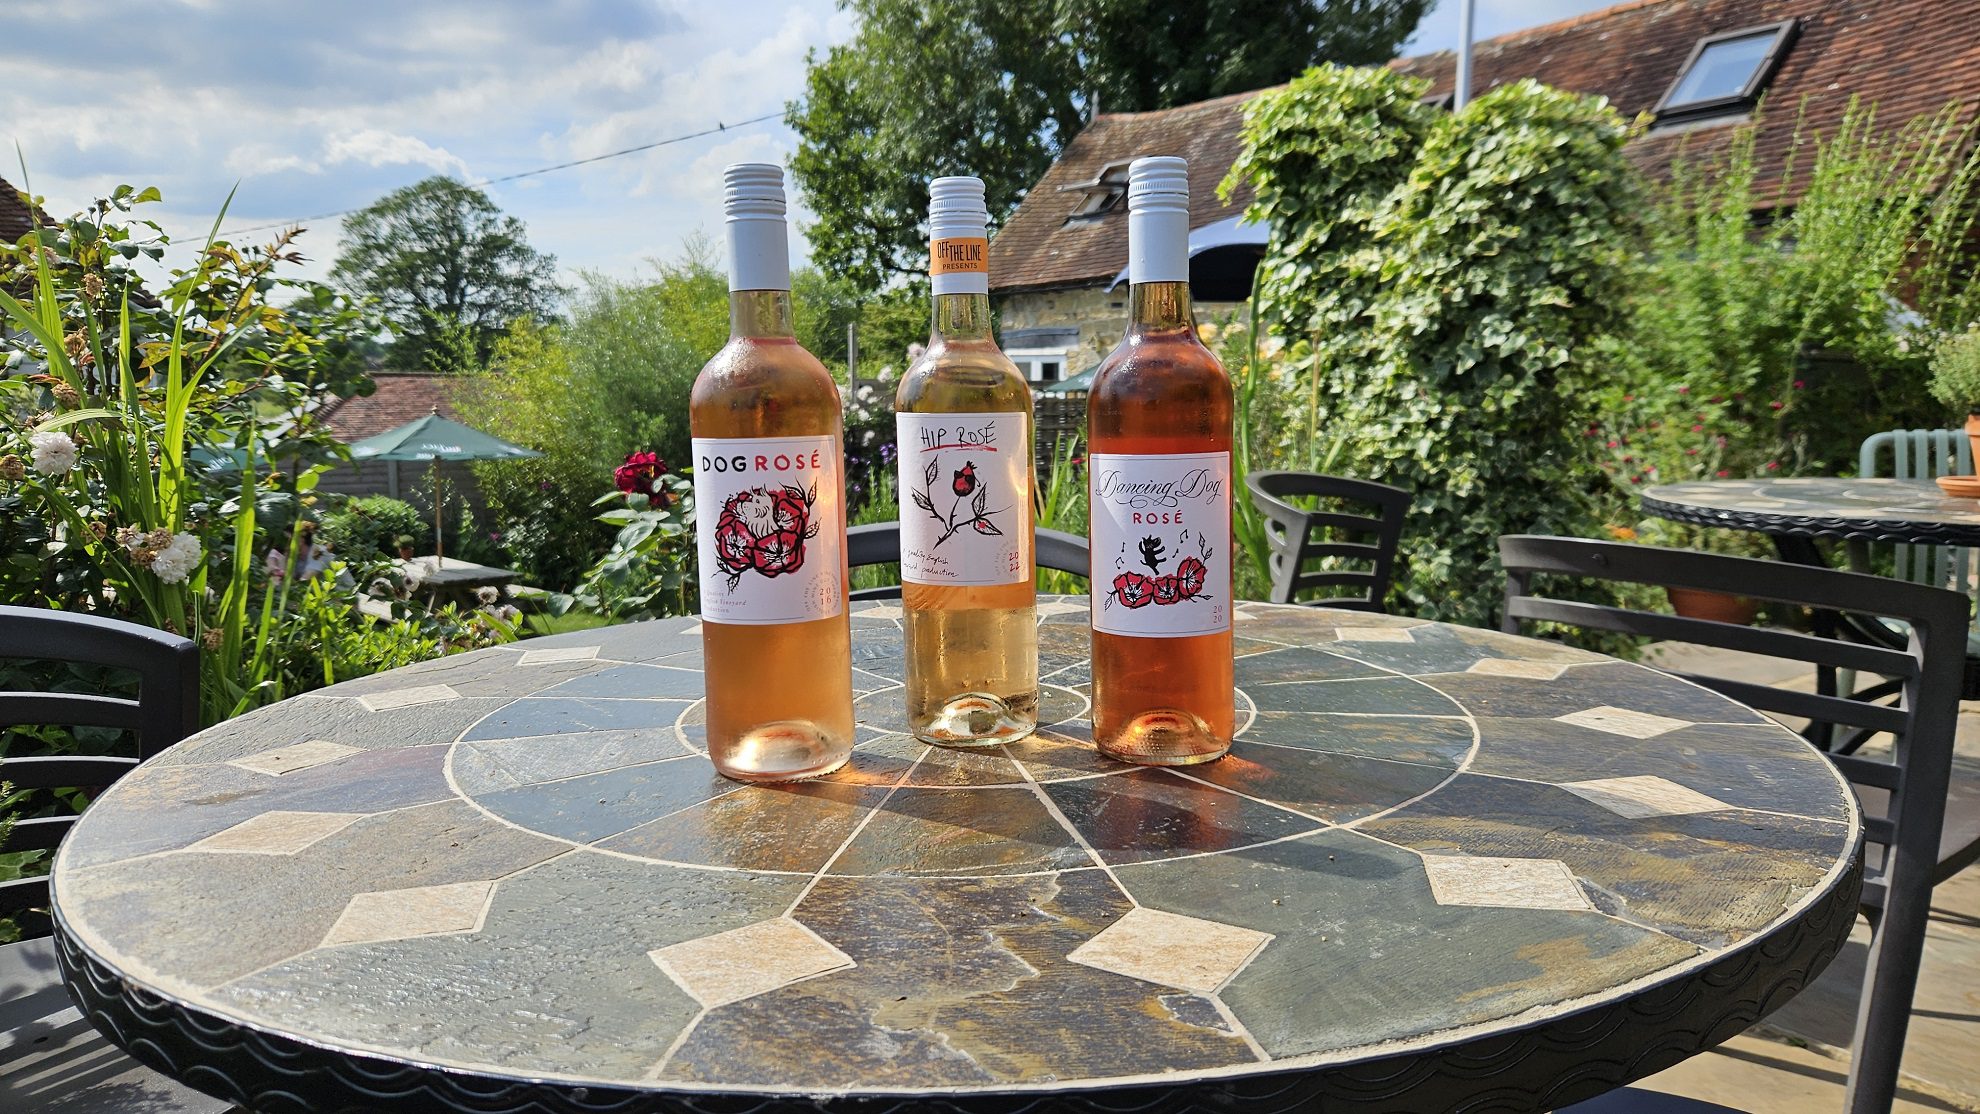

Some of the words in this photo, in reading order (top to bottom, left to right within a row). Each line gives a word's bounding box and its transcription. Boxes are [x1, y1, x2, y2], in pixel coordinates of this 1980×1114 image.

[937, 241, 950, 259] OFF
[949, 244, 964, 262] THE
[965, 244, 982, 262] LINE
[942, 262, 978, 270] PRESENTS
[920, 426, 947, 449] HIP
[956, 420, 997, 448] ROSÉ
[702, 455, 747, 473] DOG
[754, 449, 821, 472] ROSÉ
[1095, 469, 1179, 508] Dancing
[1174, 469, 1223, 505] Dog
[1132, 510, 1184, 525] ROSÉ
[1008, 551, 1019, 562] 20
[1009, 561, 1021, 572] 22
[819, 587, 831, 596] 20
[820, 595, 832, 605] 16
[1213, 605, 1223, 614] 20
[1213, 615, 1223, 624] 20
